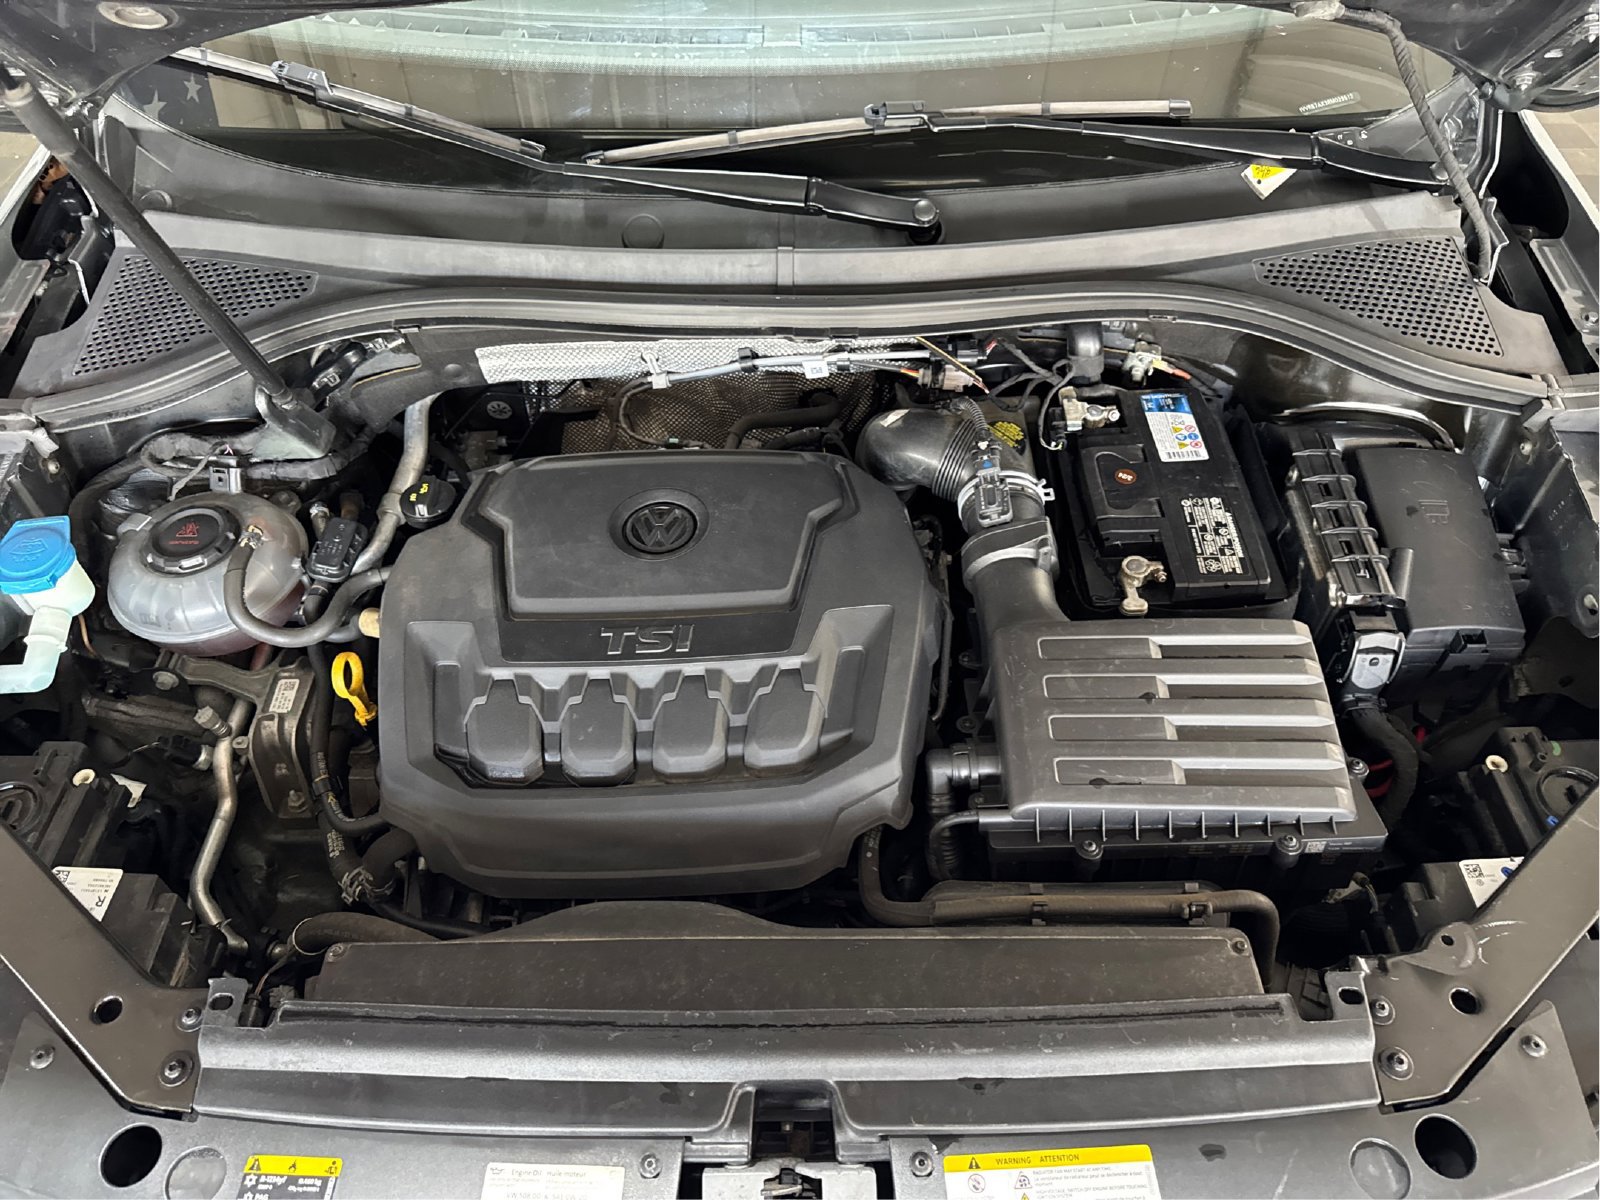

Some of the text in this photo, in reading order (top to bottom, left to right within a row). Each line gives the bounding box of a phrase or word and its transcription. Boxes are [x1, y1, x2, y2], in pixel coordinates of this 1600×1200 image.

[600, 624, 695, 655] TSI
[995, 1153, 1080, 1166] WARNING ATTENTION
